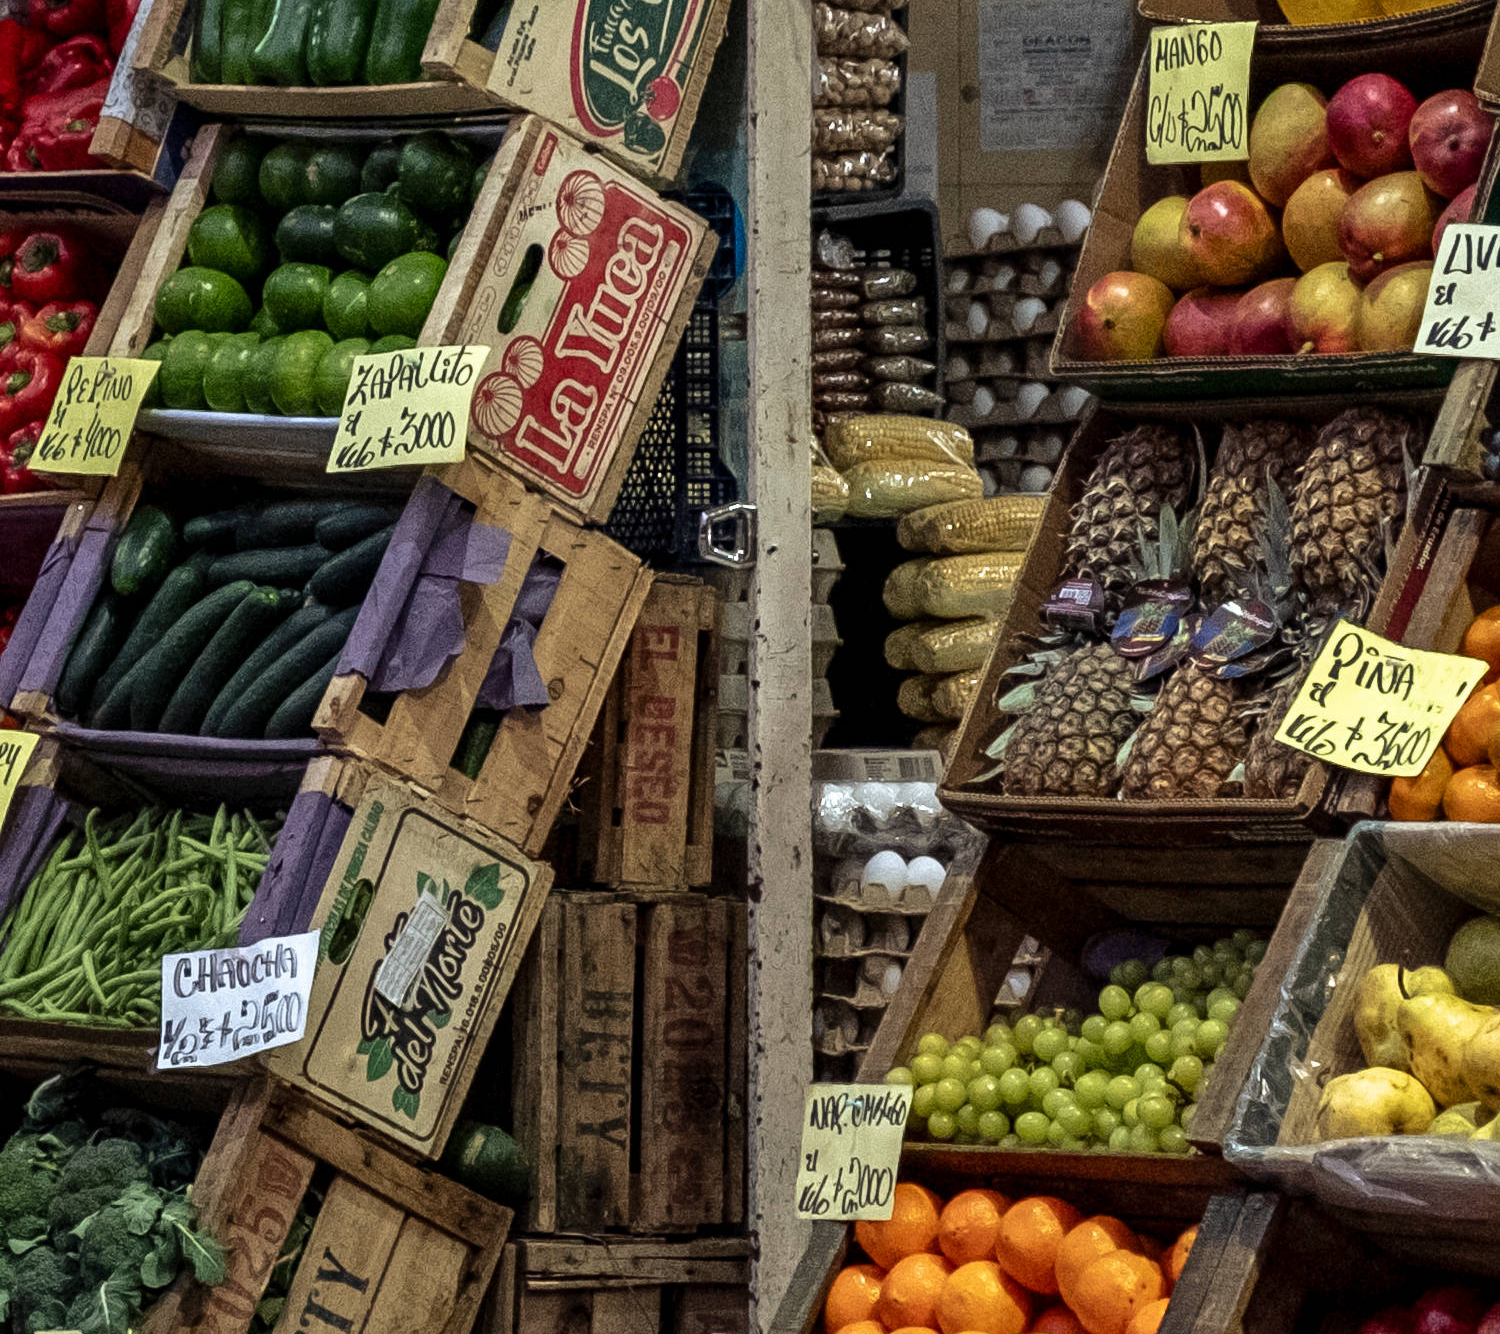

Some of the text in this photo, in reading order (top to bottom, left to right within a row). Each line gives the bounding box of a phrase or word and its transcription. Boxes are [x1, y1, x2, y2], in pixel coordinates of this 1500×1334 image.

[589, 17, 657, 105] Los
[1156, 29, 1222, 73] MANGO
[515, 214, 665, 474] La Yuca
[66, 360, 133, 405] PEPINO
[641, 625, 680, 664] EL
[1329, 632, 1414, 700] PIÑA
[402, 892, 485, 1014] Norte
[396, 1015, 436, 1095] del
